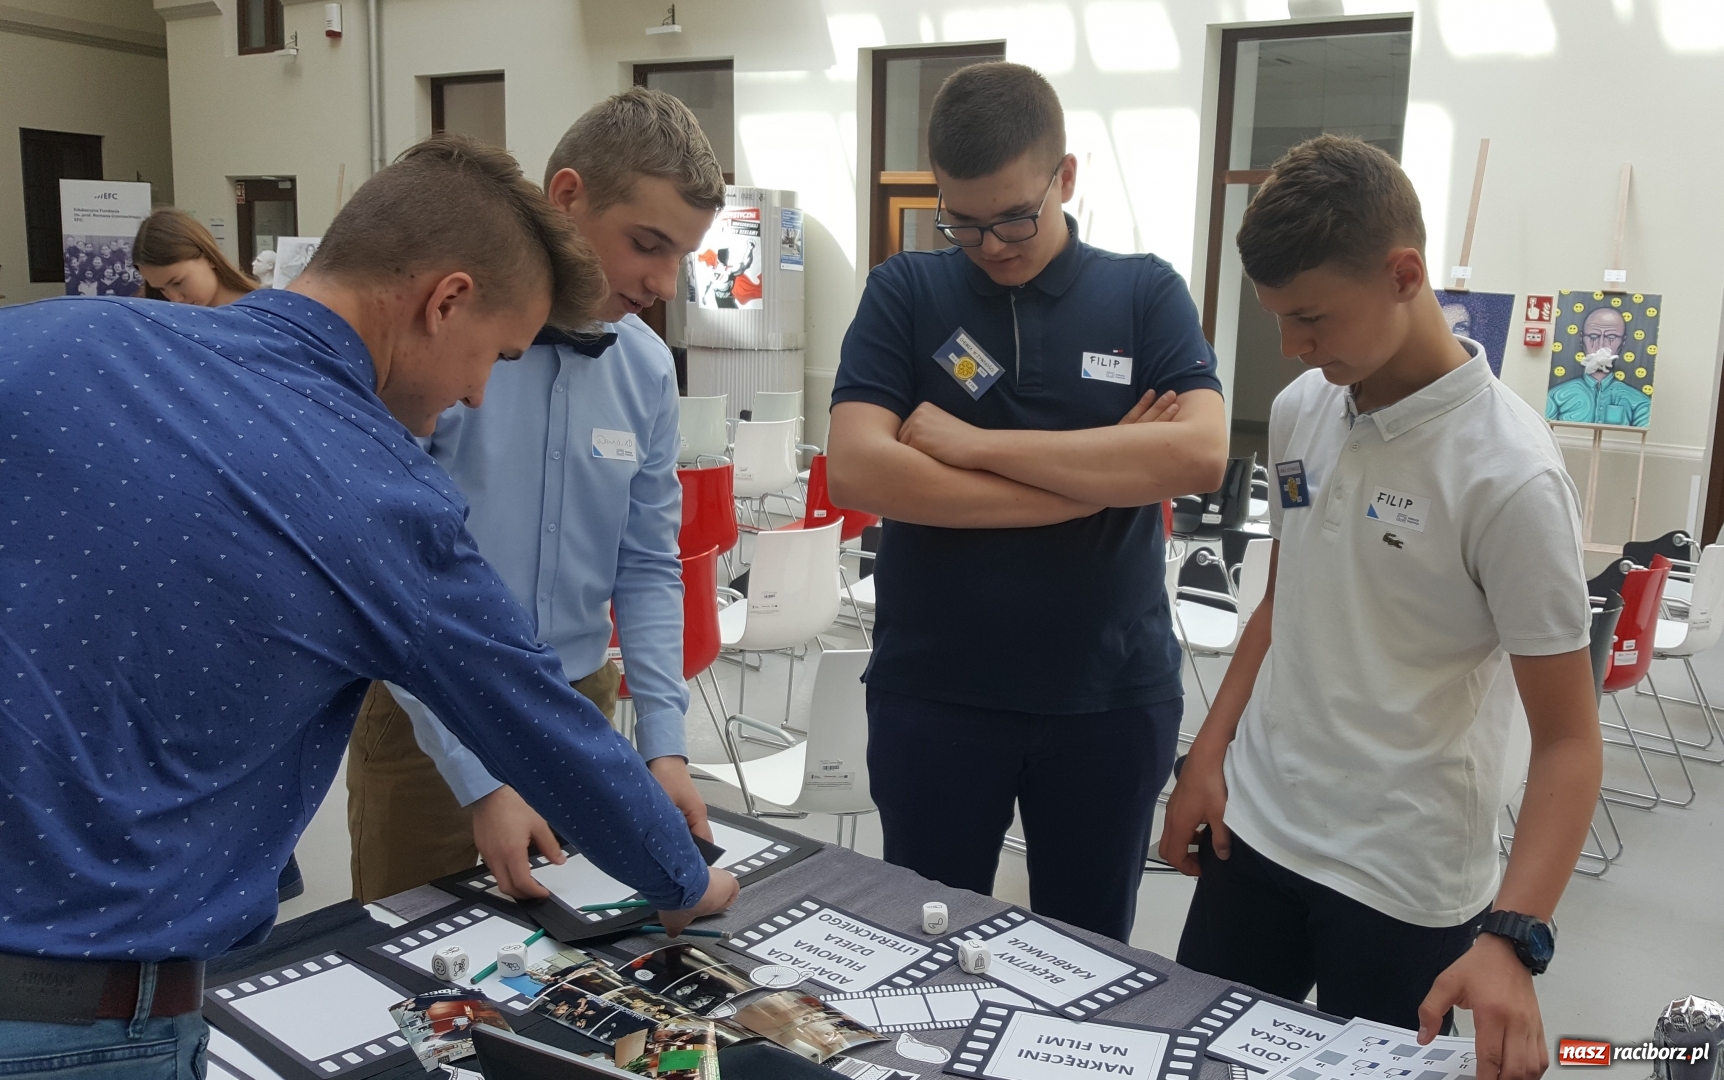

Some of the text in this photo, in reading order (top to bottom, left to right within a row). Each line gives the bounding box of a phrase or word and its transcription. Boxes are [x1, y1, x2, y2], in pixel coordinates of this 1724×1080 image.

[1089, 356, 1120, 369] FILIP
[1376, 492, 1414, 509] FILIP
[818, 912, 920, 956] LITERACKIEGO
[824, 933, 876, 957] DZIEŁA
[793, 939, 867, 972] FILMOWA
[992, 951, 1066, 984] BŁĘKITNY
[1006, 937, 1096, 980] KARBUNKUŁ
[1250, 1027, 1310, 1051] OCKA
[1272, 1018, 1327, 1042] MESA
[1036, 1034, 1129, 1056] NA FILM!
[1017, 1048, 1134, 1076] NAKRĘCENI
